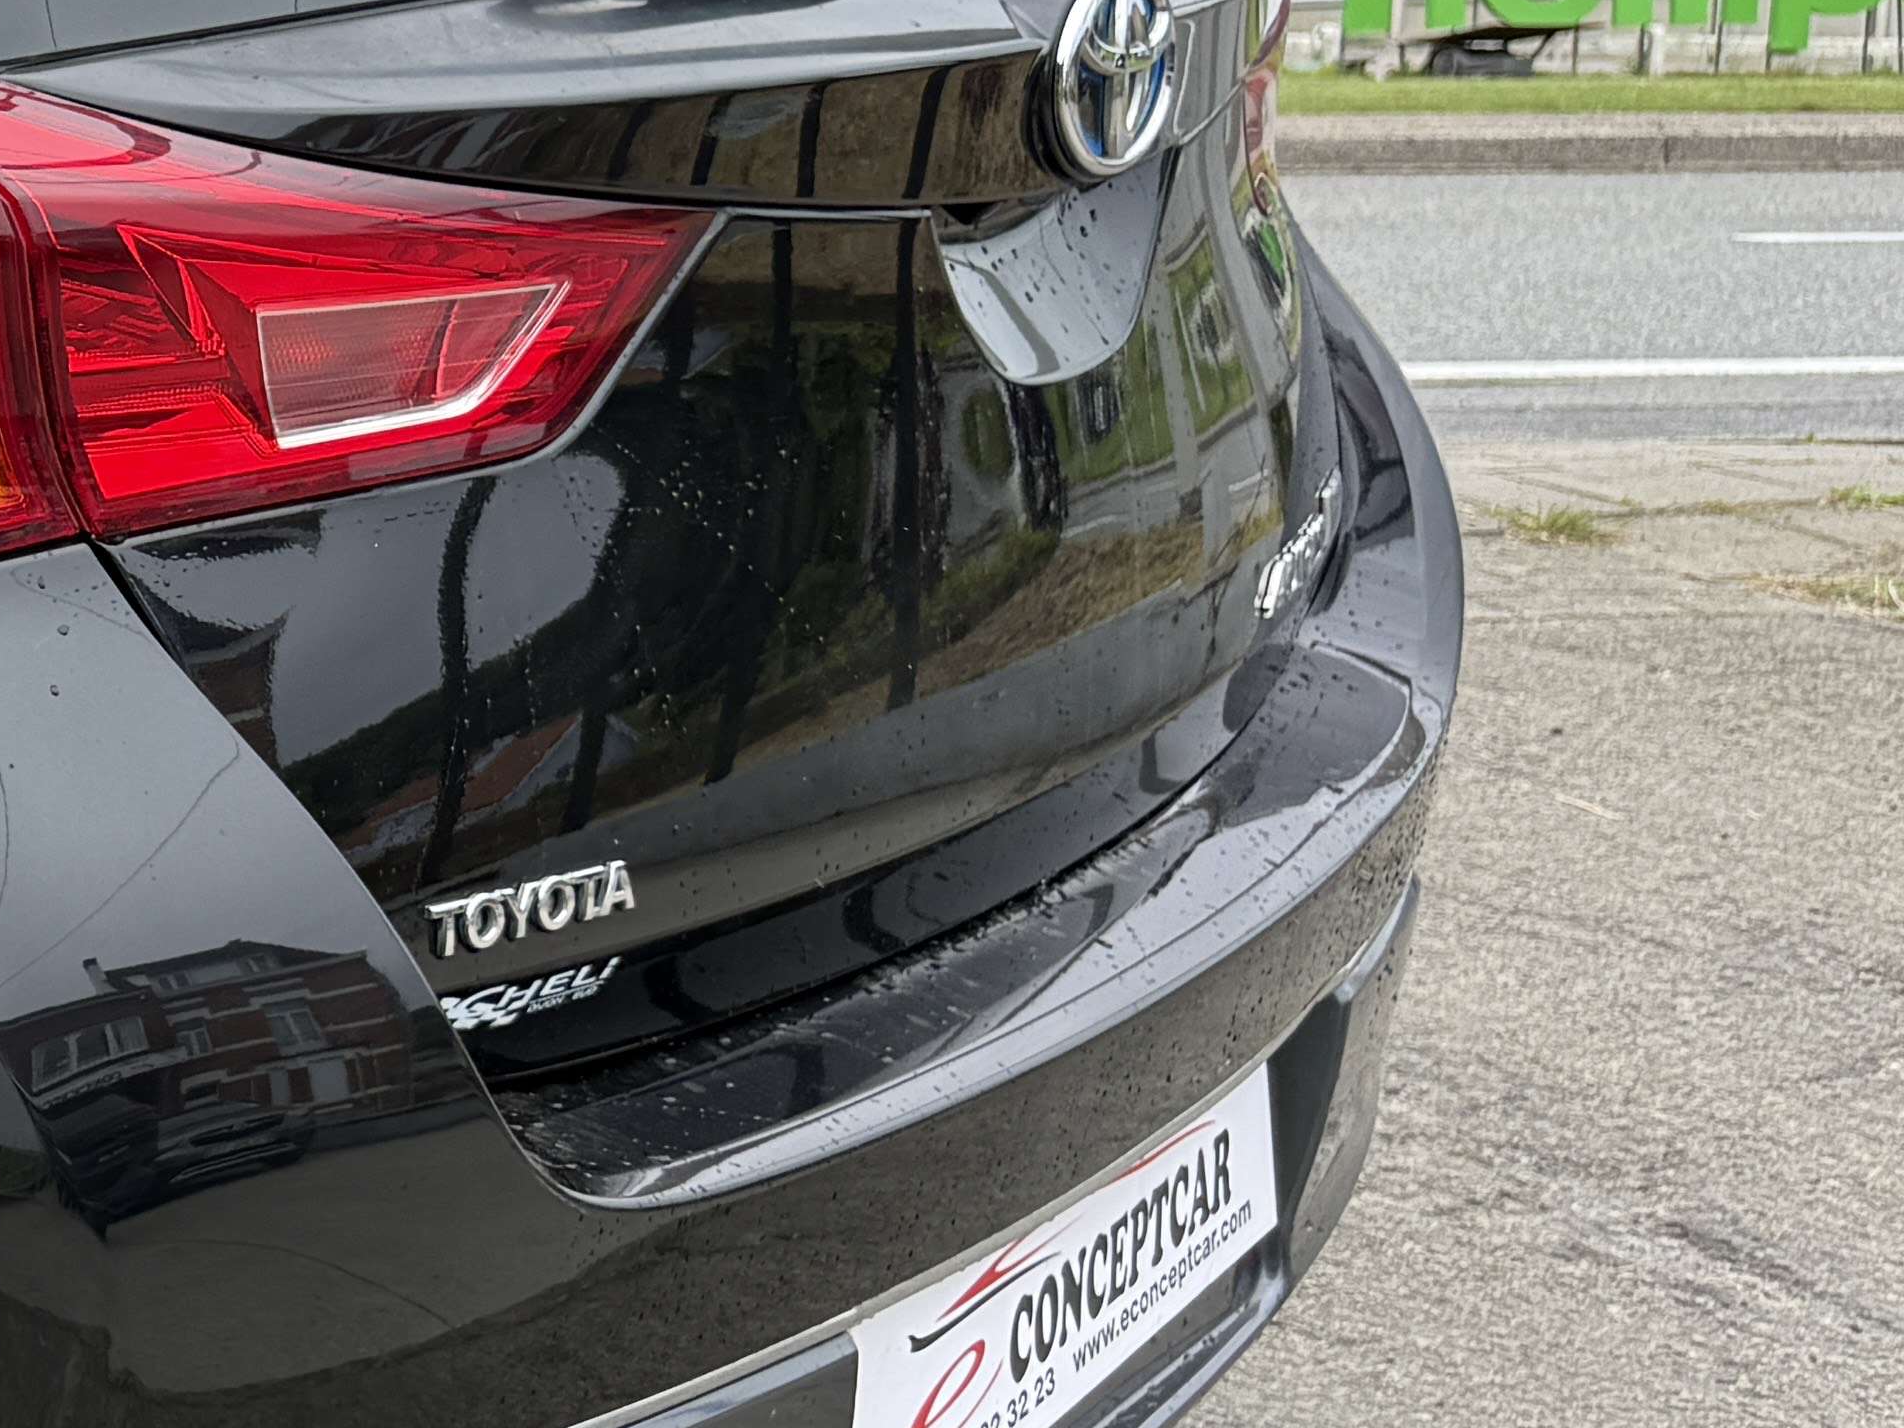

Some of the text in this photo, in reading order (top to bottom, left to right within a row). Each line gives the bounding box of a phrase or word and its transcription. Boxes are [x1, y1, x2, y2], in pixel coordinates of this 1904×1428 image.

[424, 859, 636, 958] TOYOTA
[1008, 1127, 1231, 1384] CONCEPTCAR
[1072, 1199, 1253, 1373] www.econceptcar.com
[1034, 1367, 1057, 1409] 23
